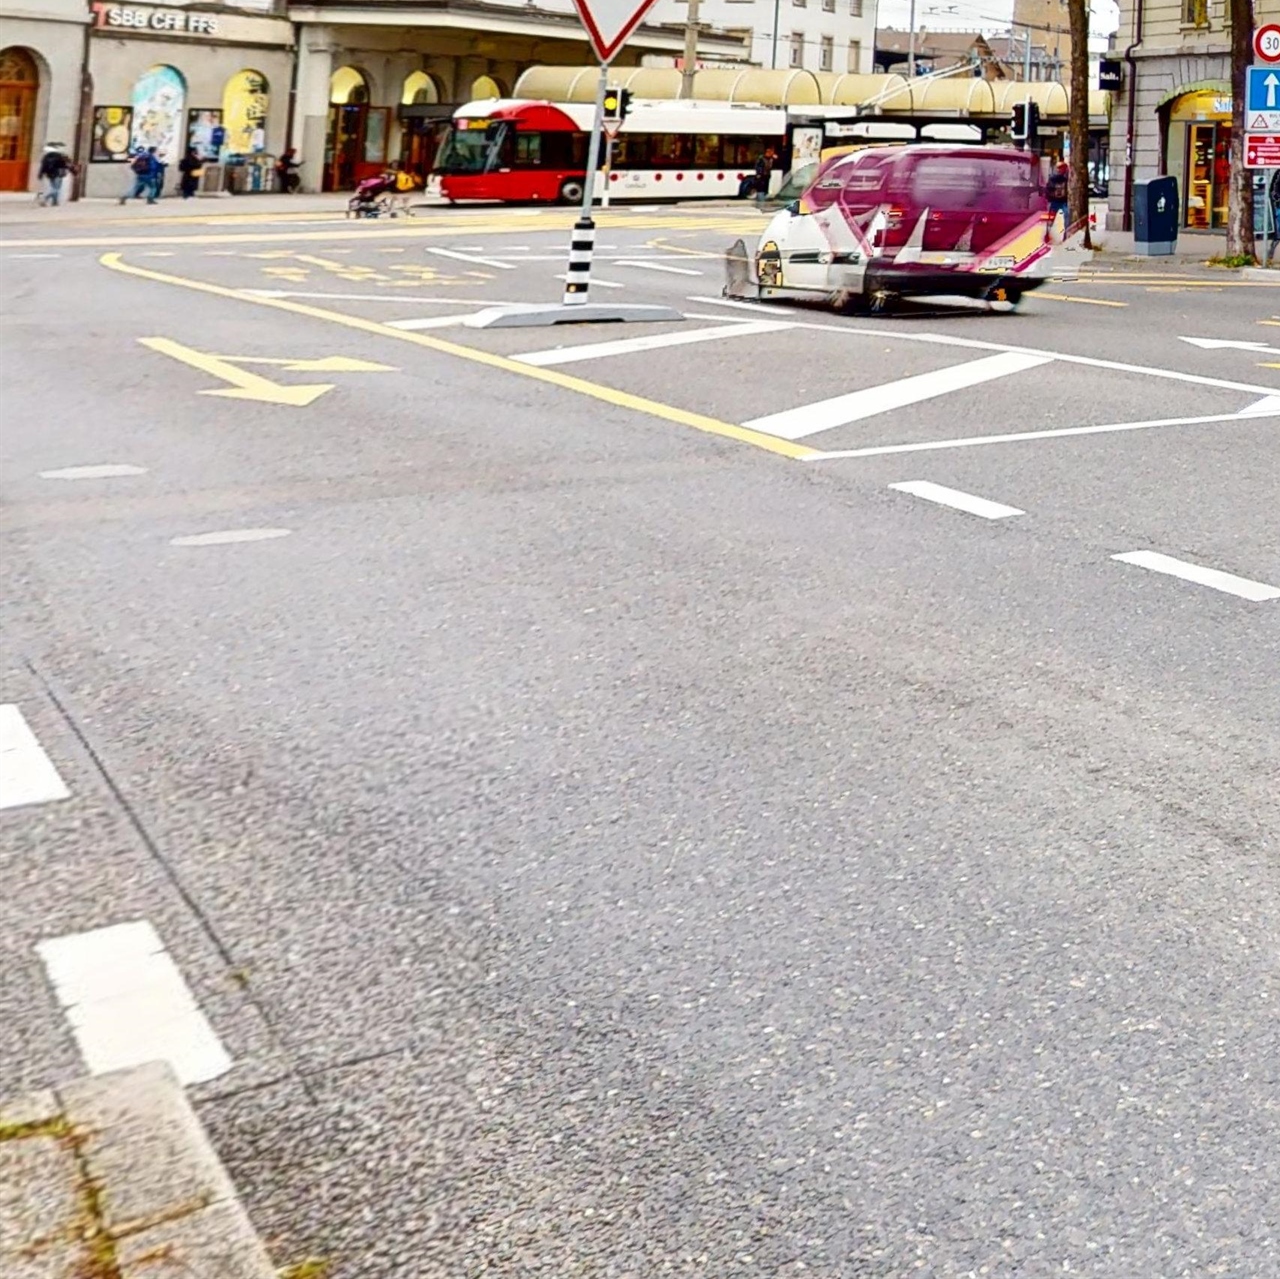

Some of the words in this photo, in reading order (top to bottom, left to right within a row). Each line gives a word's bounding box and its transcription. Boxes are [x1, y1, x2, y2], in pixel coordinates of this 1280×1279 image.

[108, 9, 147, 28] SBB
[151, 13, 187, 31] CFF
[188, 16, 221, 35] FFS
[1265, 36, 1280, 51] 30
[1100, 71, 1119, 80] Salt.
